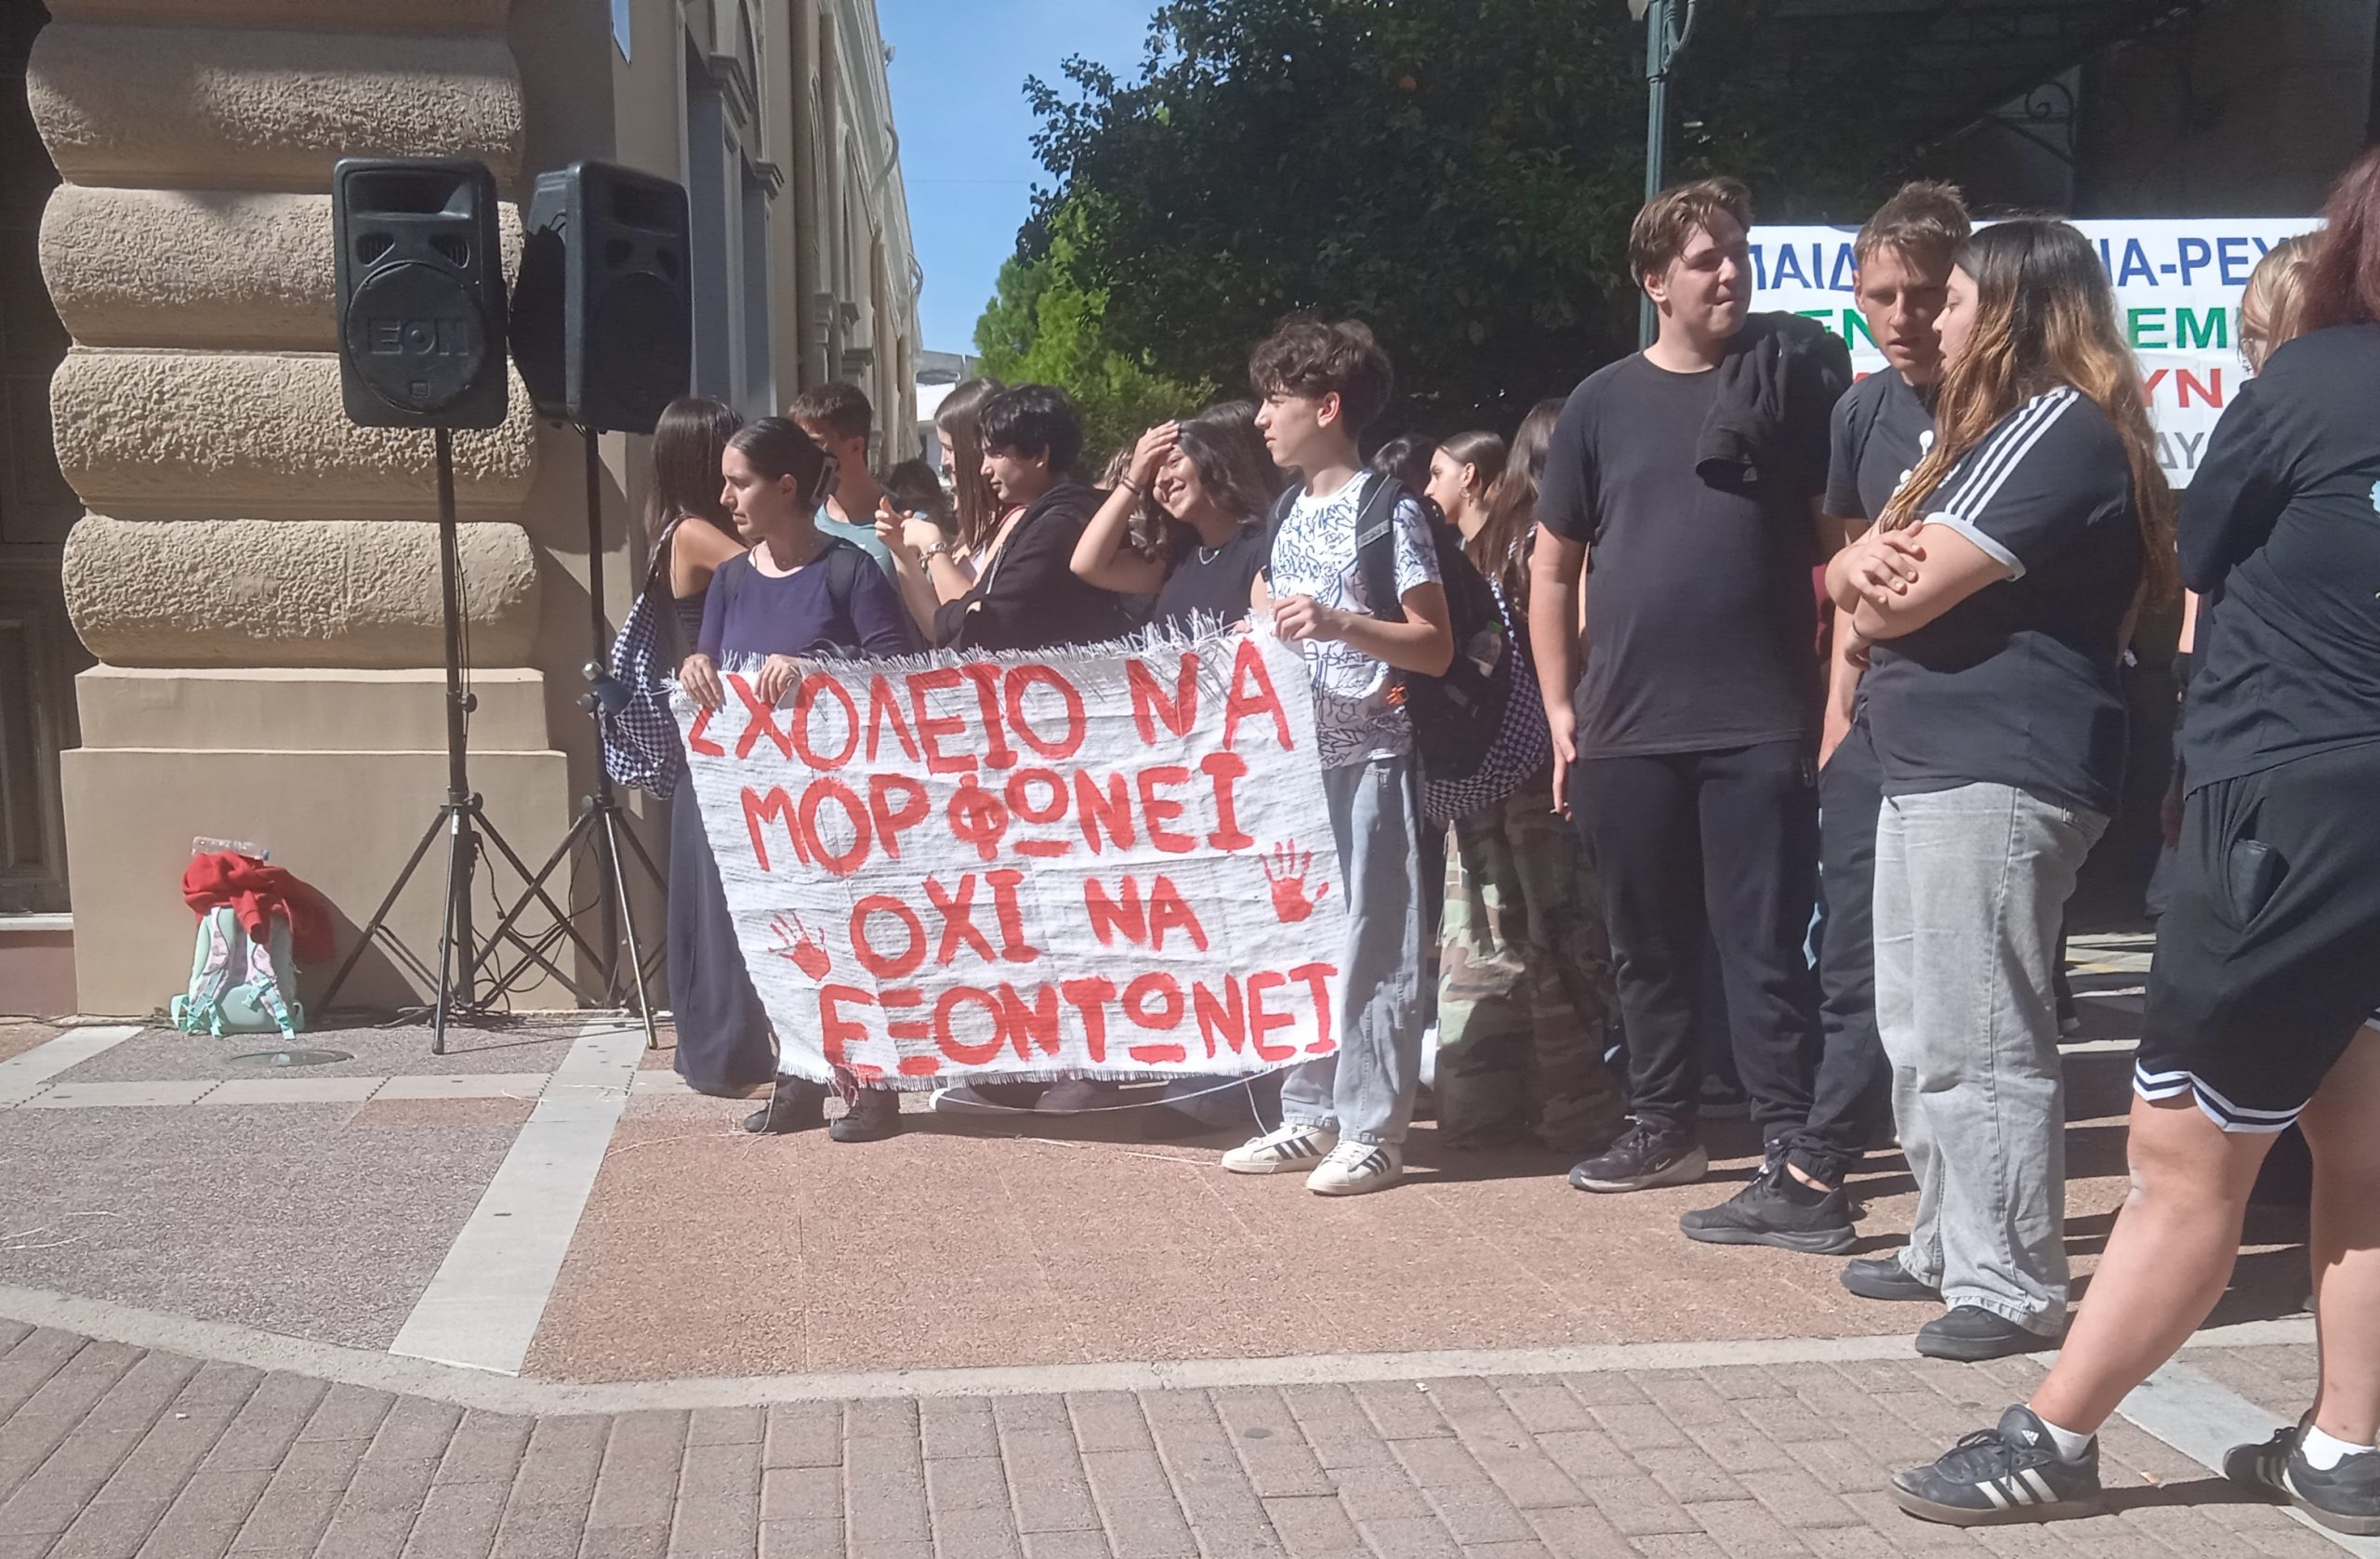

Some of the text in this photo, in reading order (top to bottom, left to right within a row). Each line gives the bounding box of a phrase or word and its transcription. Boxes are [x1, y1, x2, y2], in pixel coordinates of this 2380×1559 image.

[368, 318, 469, 355] EON
[1127, 639, 1293, 750] ΝΑ
[850, 868, 1209, 979] ΟΧΙ ΝΑ
